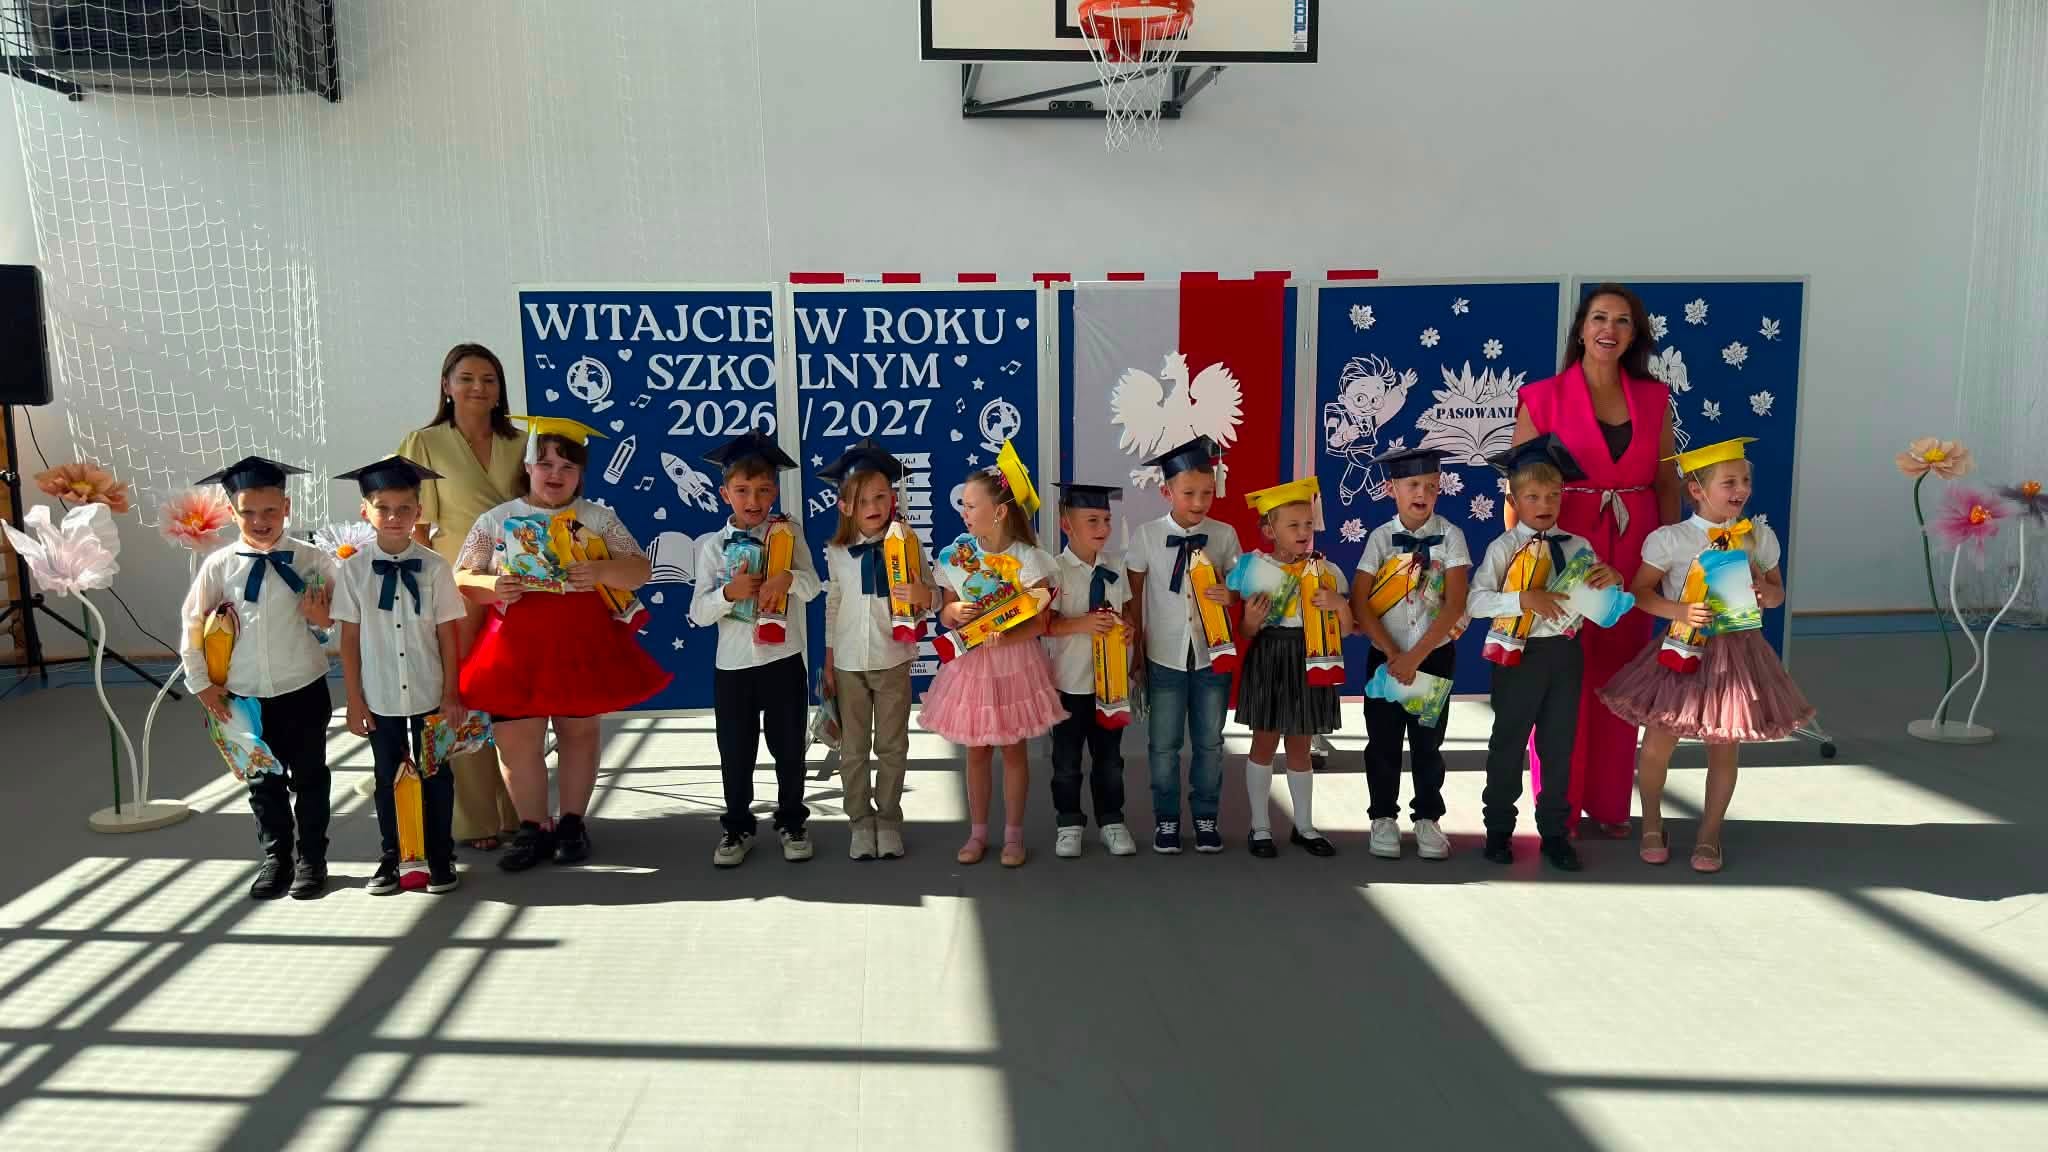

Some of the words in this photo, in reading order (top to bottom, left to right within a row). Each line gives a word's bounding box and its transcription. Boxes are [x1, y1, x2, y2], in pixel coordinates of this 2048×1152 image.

[524, 303, 773, 343] WITAJCIE
[796, 308, 848, 344] W
[862, 308, 1006, 344] ROKU
[1436, 406, 1519, 420] PASOWANI
